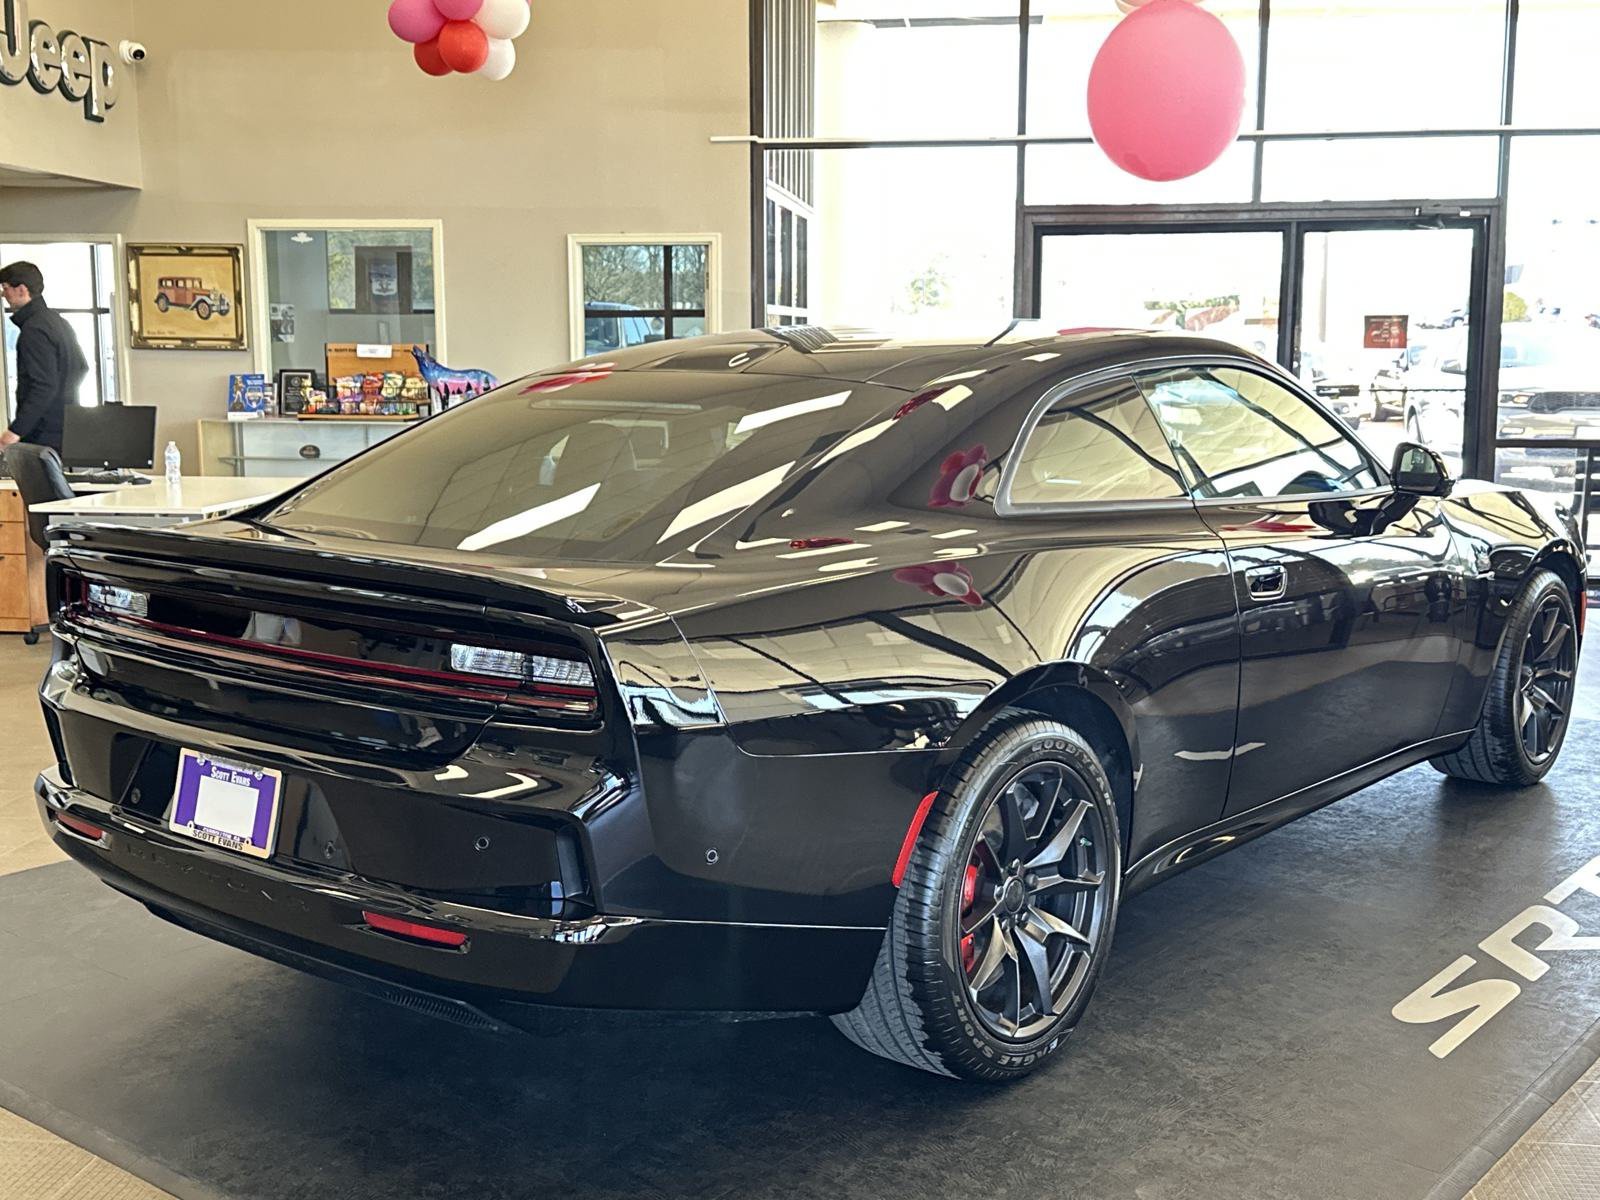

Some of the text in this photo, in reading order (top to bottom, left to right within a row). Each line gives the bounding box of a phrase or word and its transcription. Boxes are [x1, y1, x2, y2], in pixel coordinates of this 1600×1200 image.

[0, 0, 119, 123] Jeep
[1032, 740, 1112, 806] GOODYEAR
[192, 829, 217, 843] SCOTT
[218, 836, 243, 851] EVANS
[952, 991, 1059, 1066] EAGLE SPORT
